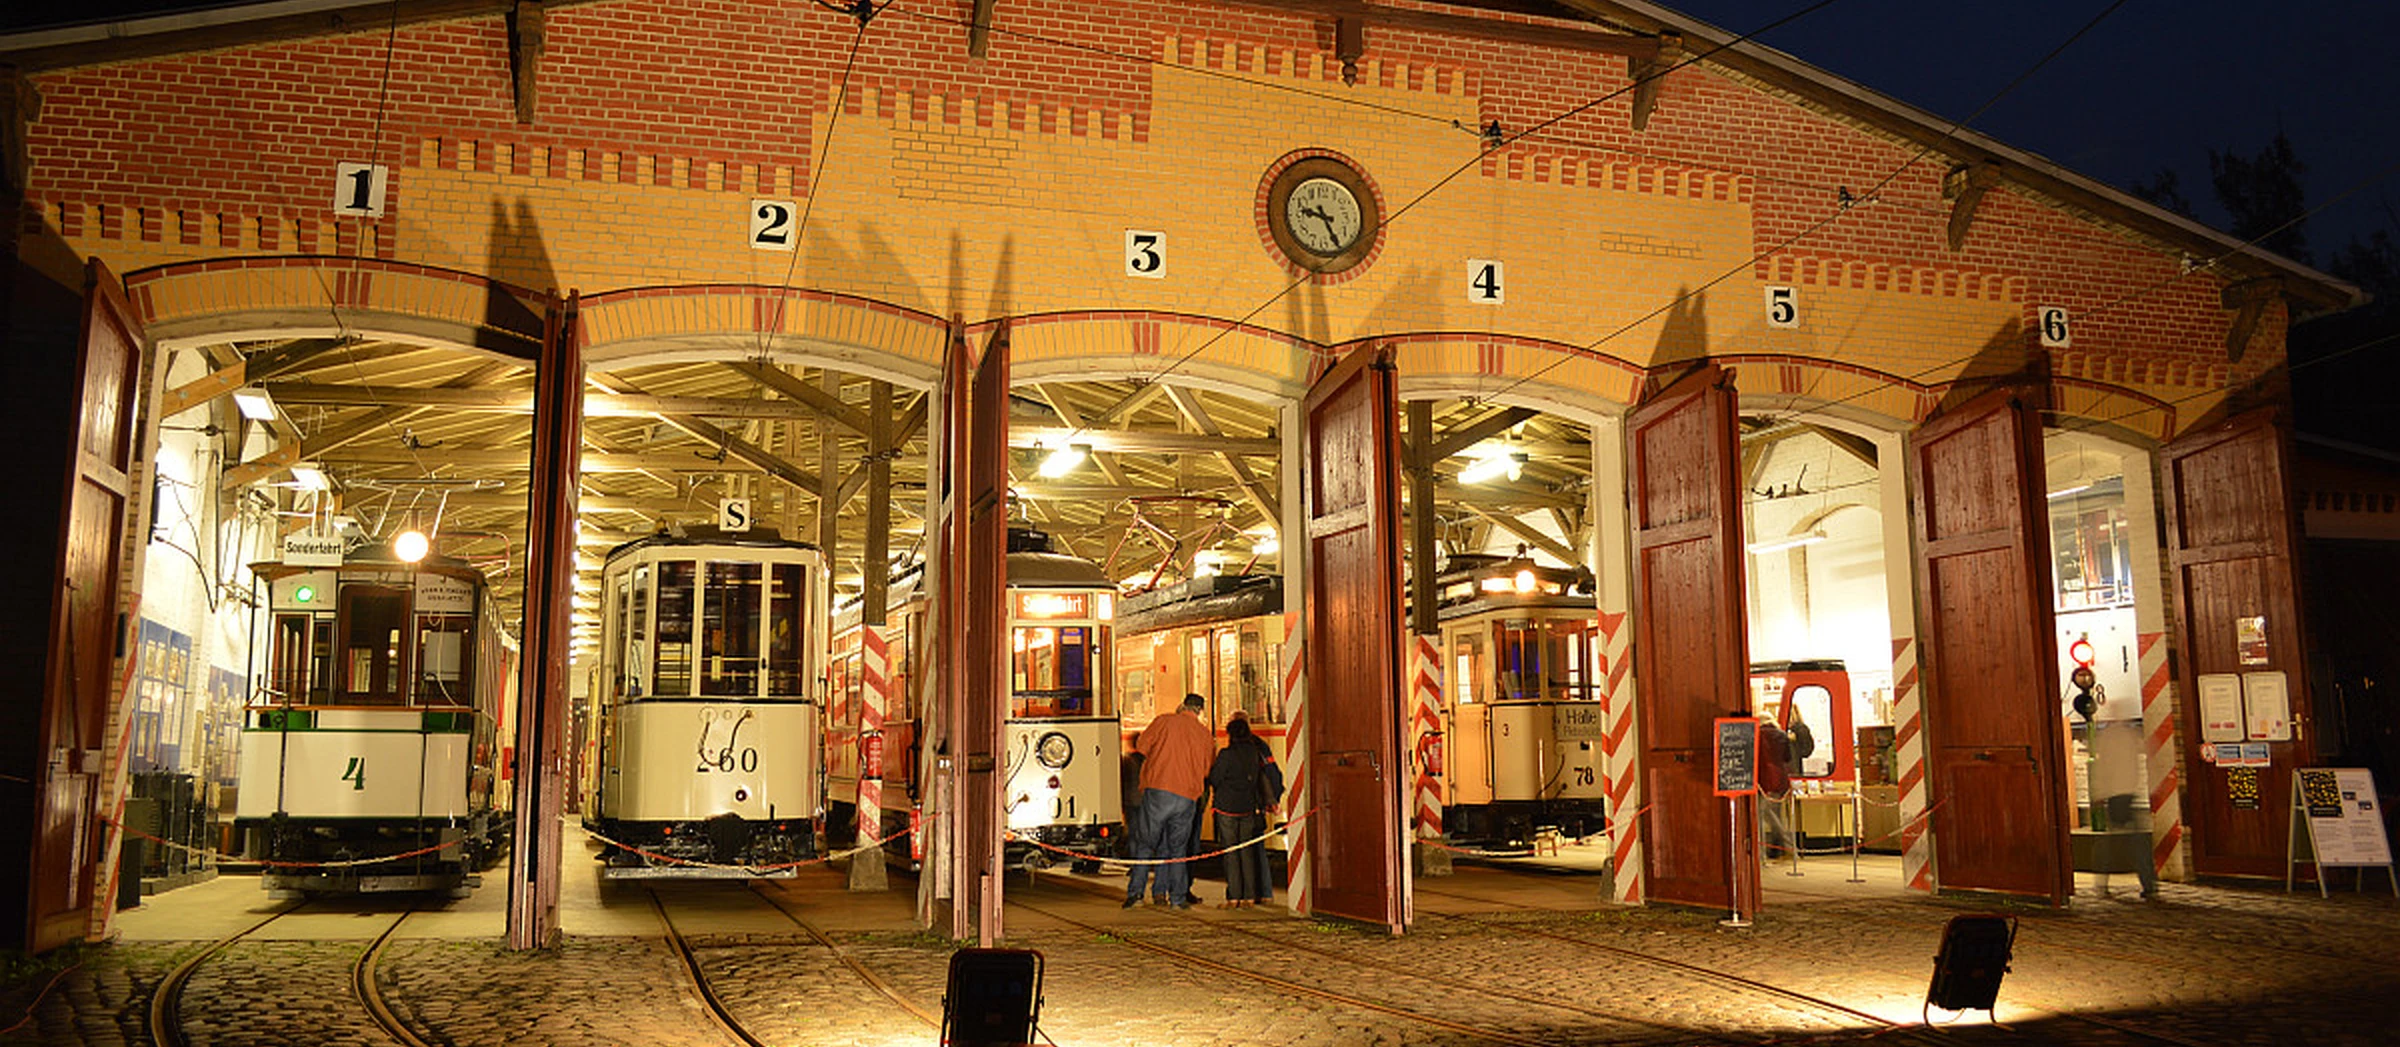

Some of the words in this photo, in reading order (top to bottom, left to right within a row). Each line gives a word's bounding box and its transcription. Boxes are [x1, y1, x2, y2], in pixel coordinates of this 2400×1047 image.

[345, 170, 373, 211] 1
[756, 205, 789, 244] 2
[1131, 236, 1160, 272] 3
[1473, 264, 1500, 298] 4
[1773, 289, 1795, 323] 5
[2043, 310, 2066, 343] 6
[727, 502, 745, 528] S
[286, 541, 341, 555] Sonderfahrt
[1503, 723, 1509, 737] 3
[341, 757, 367, 791] 4
[697, 747, 757, 773] 260
[1573, 766, 1594, 787] 78
